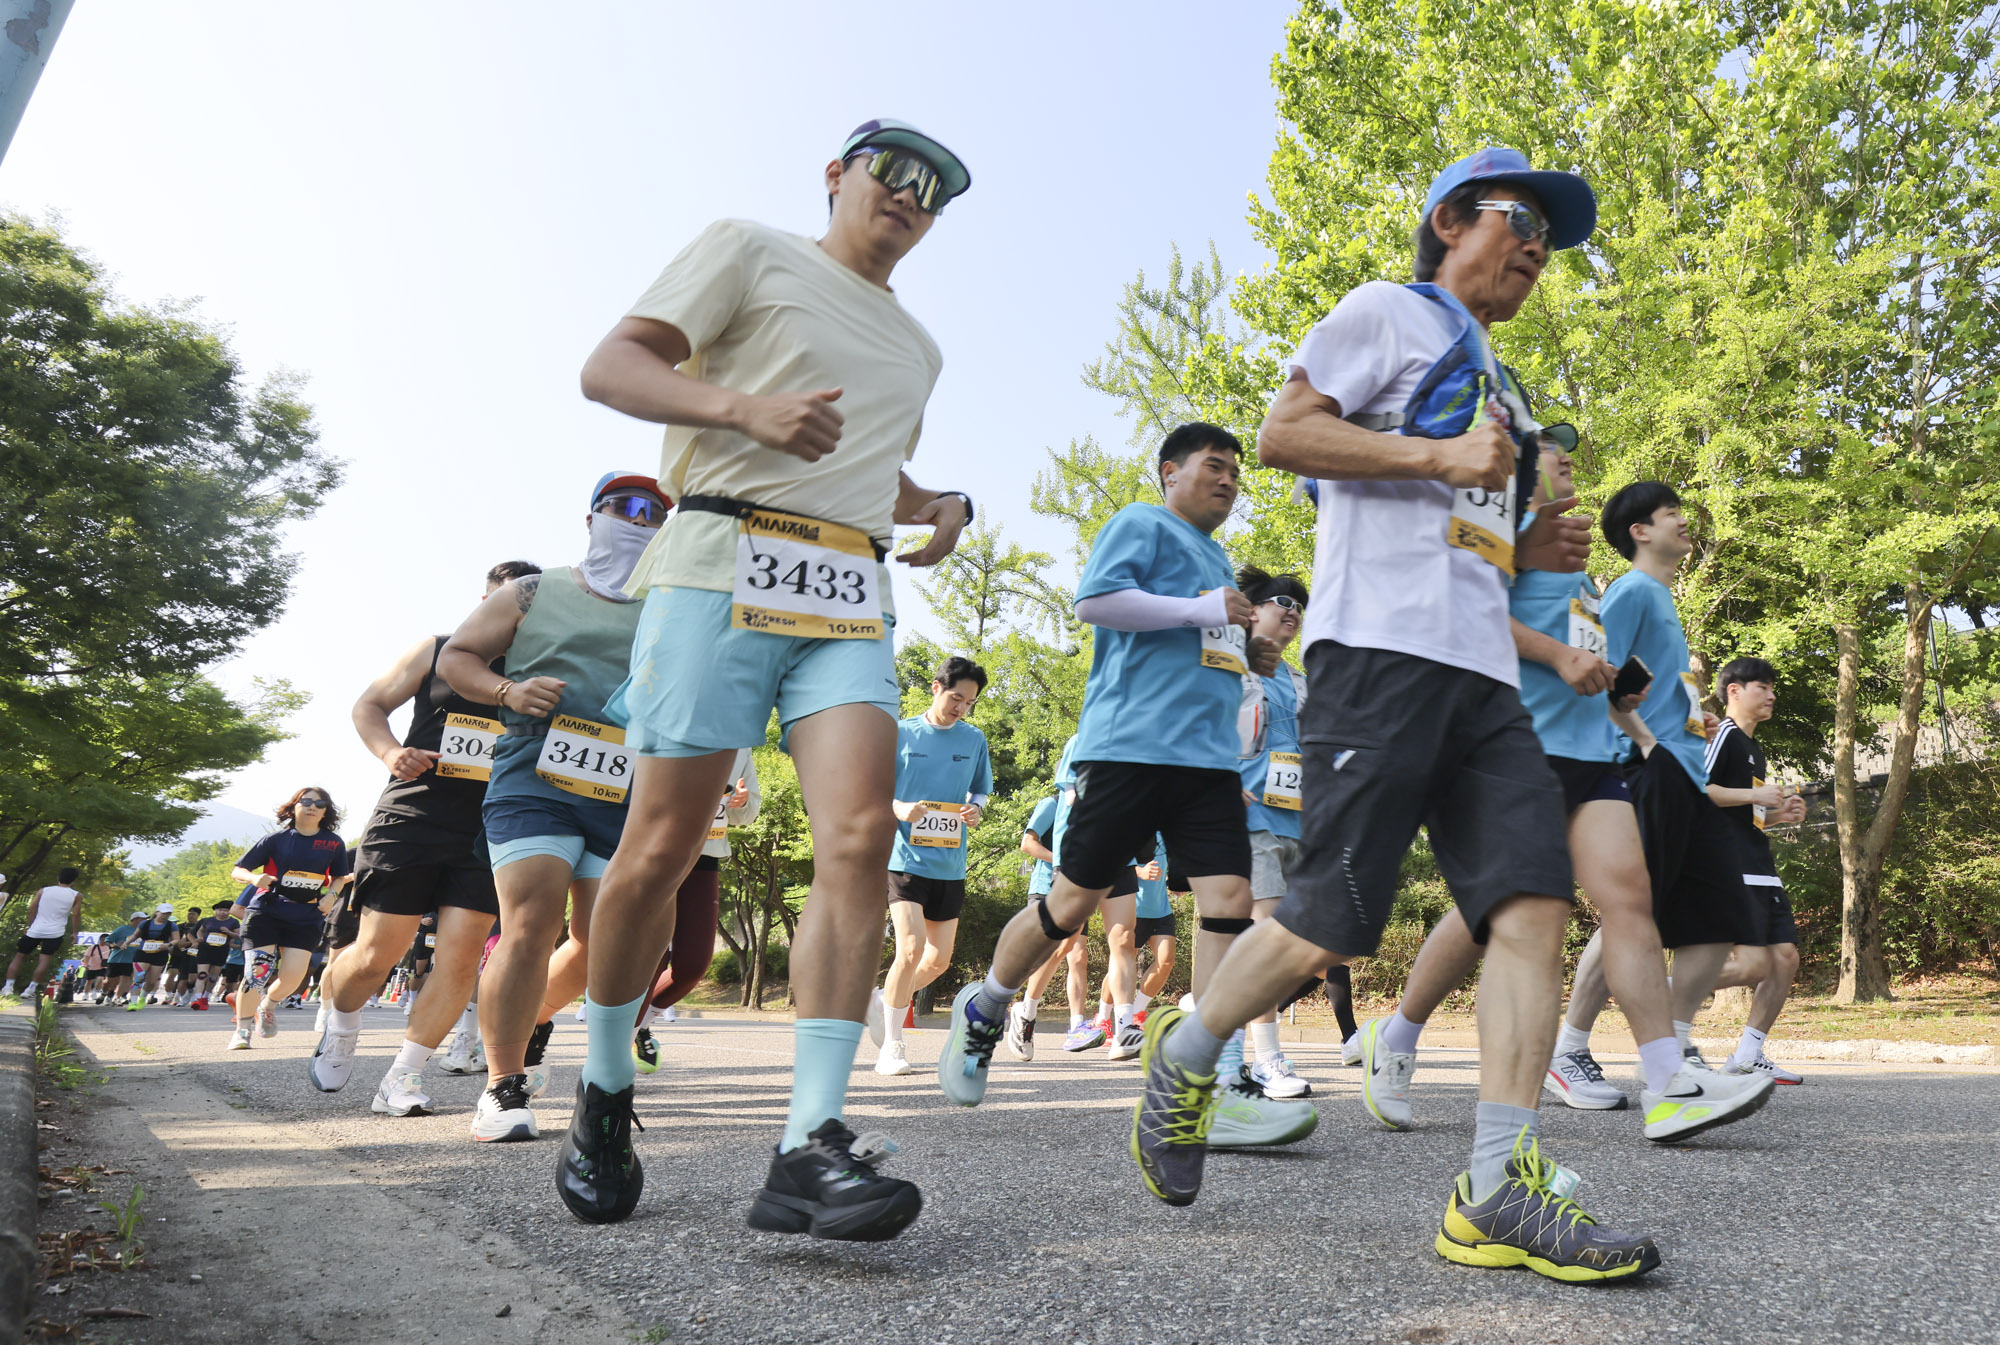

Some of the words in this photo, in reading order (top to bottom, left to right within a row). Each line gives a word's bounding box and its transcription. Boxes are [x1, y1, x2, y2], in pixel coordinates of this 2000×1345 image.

[747, 553, 866, 604] 3433
[452, 716, 490, 730] 시사저널
[557, 717, 602, 737] 시사저널
[548, 741, 628, 777] 3418
[915, 816, 958, 832] 2059
